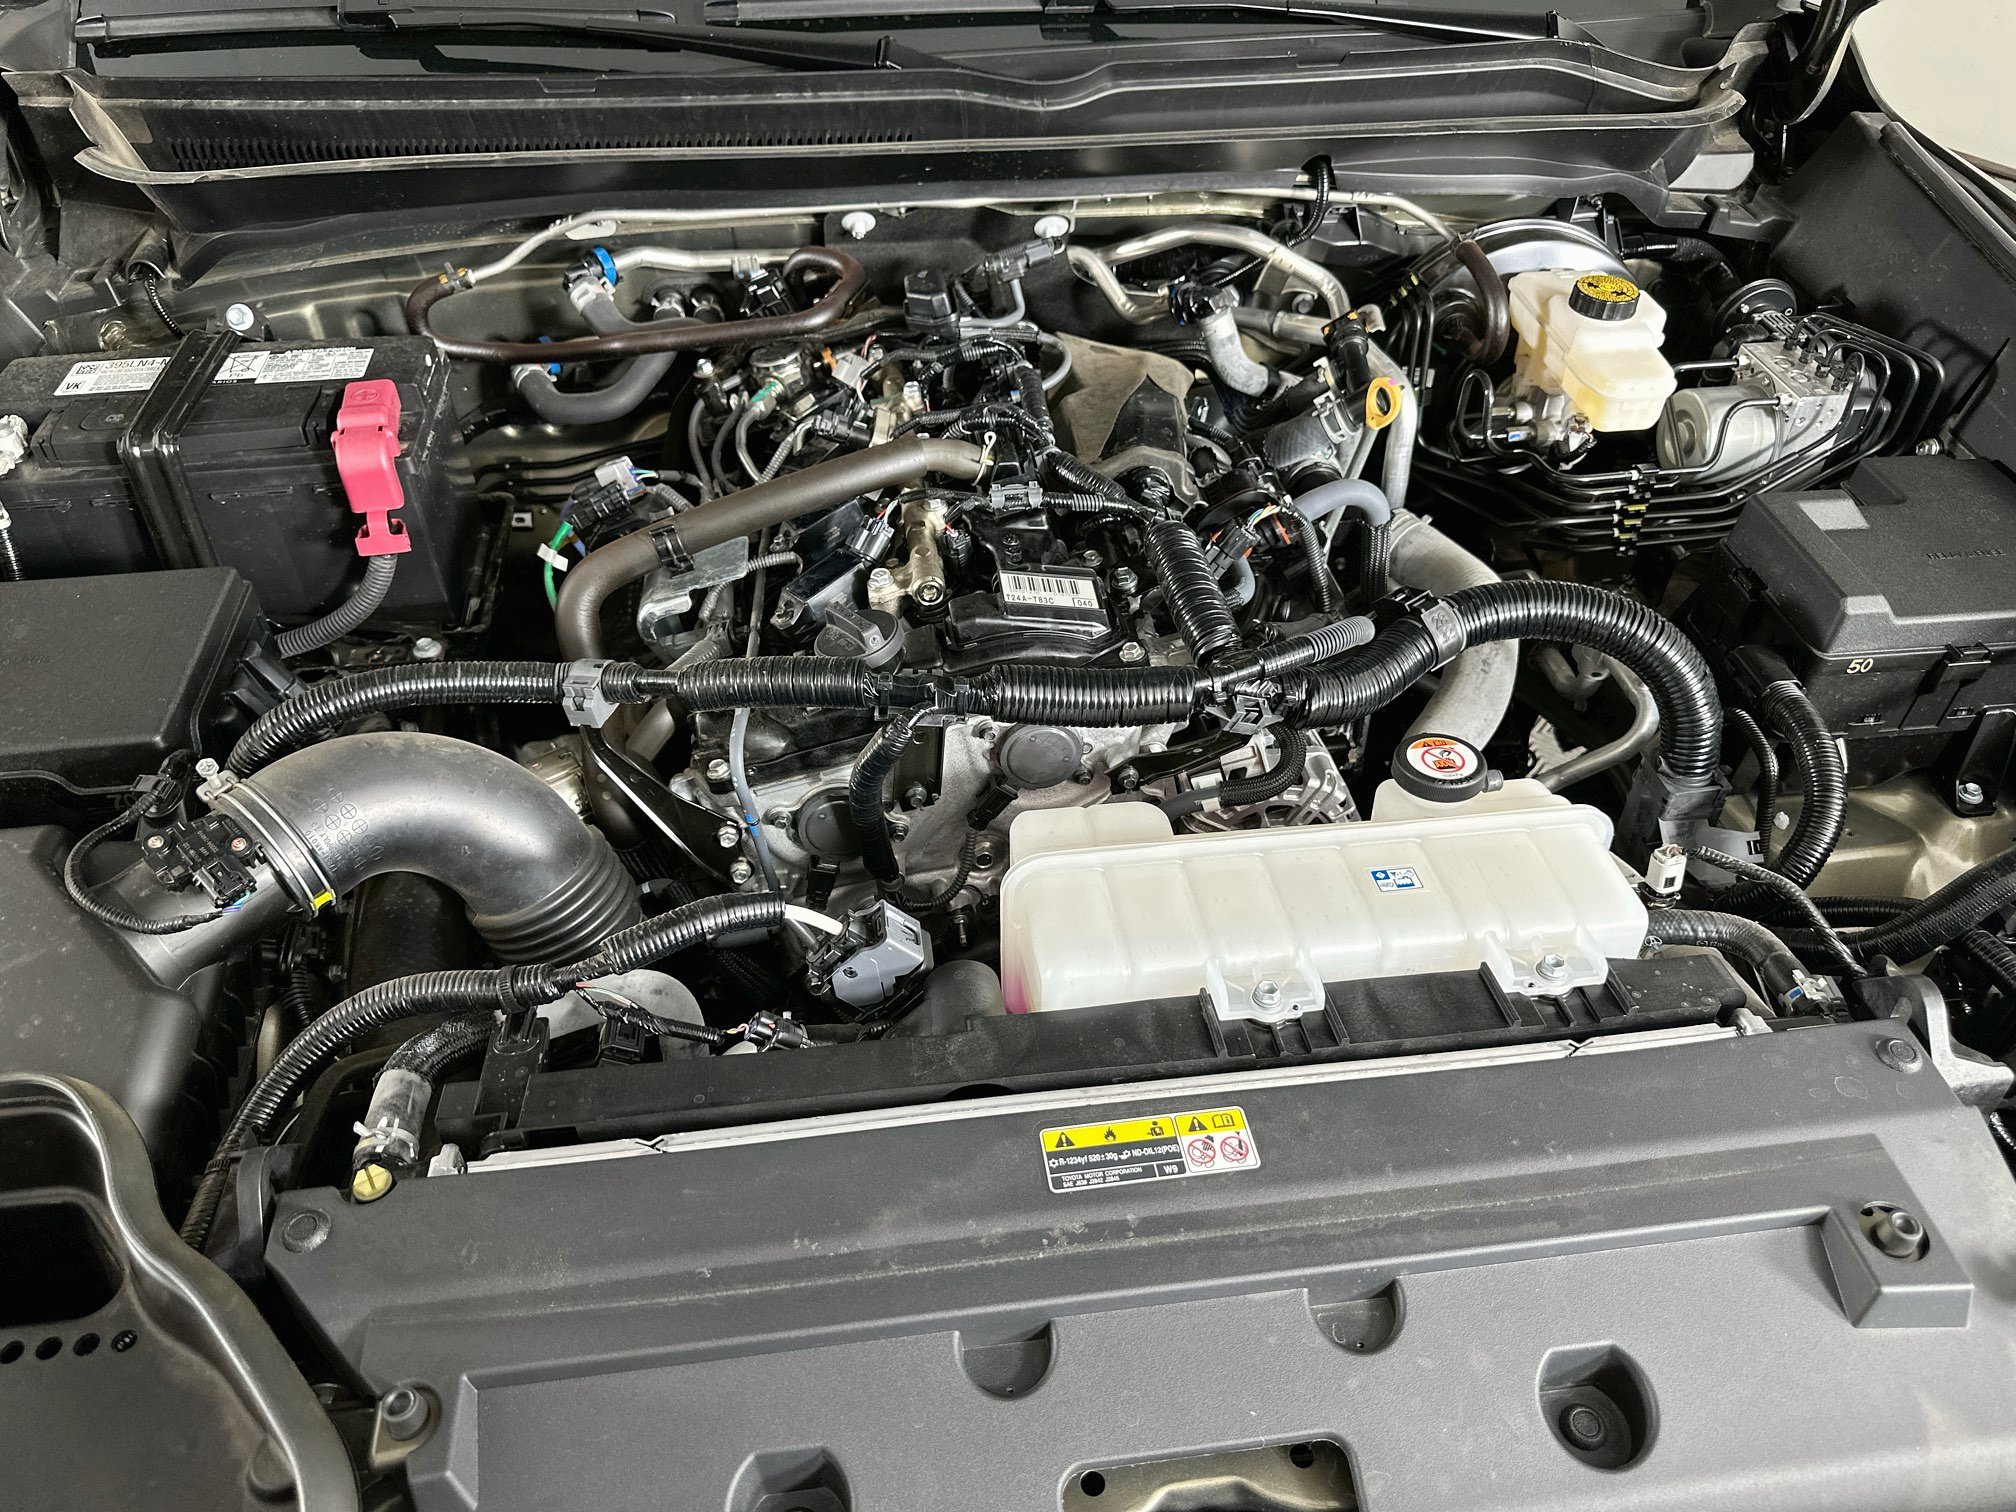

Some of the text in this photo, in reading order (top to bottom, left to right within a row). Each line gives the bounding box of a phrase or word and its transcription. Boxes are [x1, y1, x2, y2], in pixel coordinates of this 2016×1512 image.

[66, 382, 82, 390] VK
[1006, 594, 1054, 604] T24A-T83C
[1846, 658, 1874, 674] 50
[1105, 1166, 1142, 1176] CORPORATION
[1163, 1164, 1179, 1174] W9
